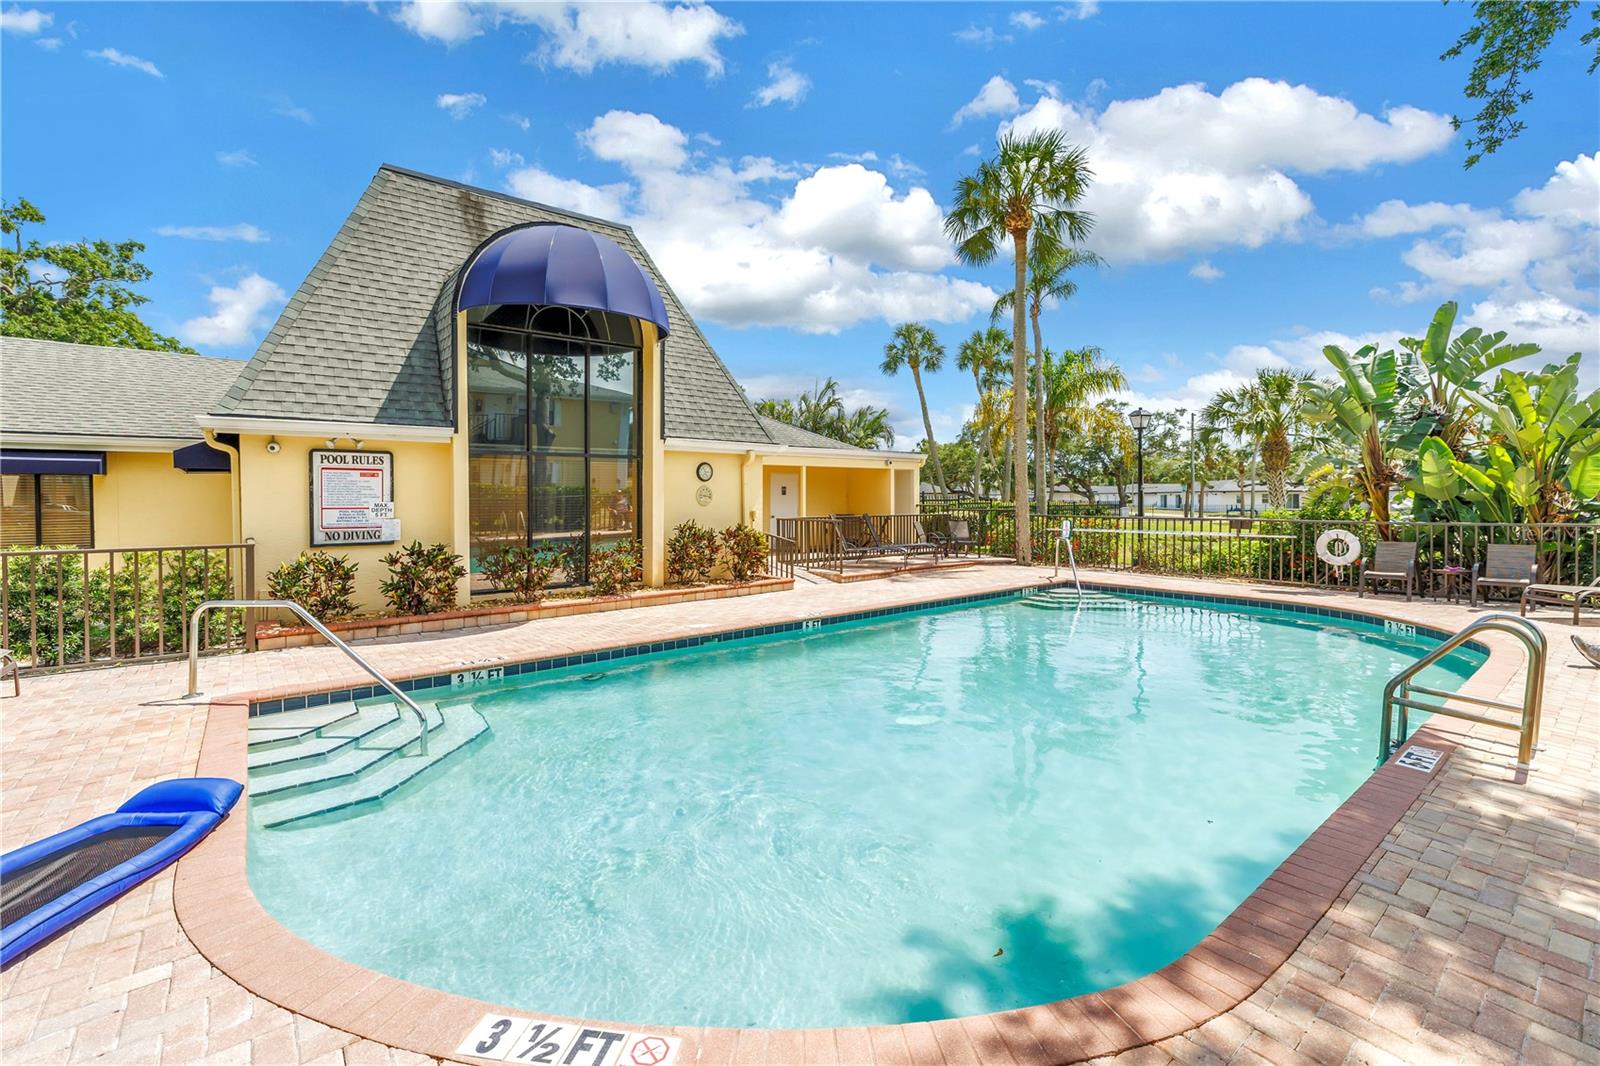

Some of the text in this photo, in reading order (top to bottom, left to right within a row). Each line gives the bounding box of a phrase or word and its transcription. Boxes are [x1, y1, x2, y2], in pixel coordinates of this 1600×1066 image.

[320, 454, 384, 465] POOL RULES
[324, 530, 381, 542] NO DIVING
[487, 667, 502, 680] FT
[475, 1018, 512, 1054] 3
[563, 1028, 625, 1066] FT
